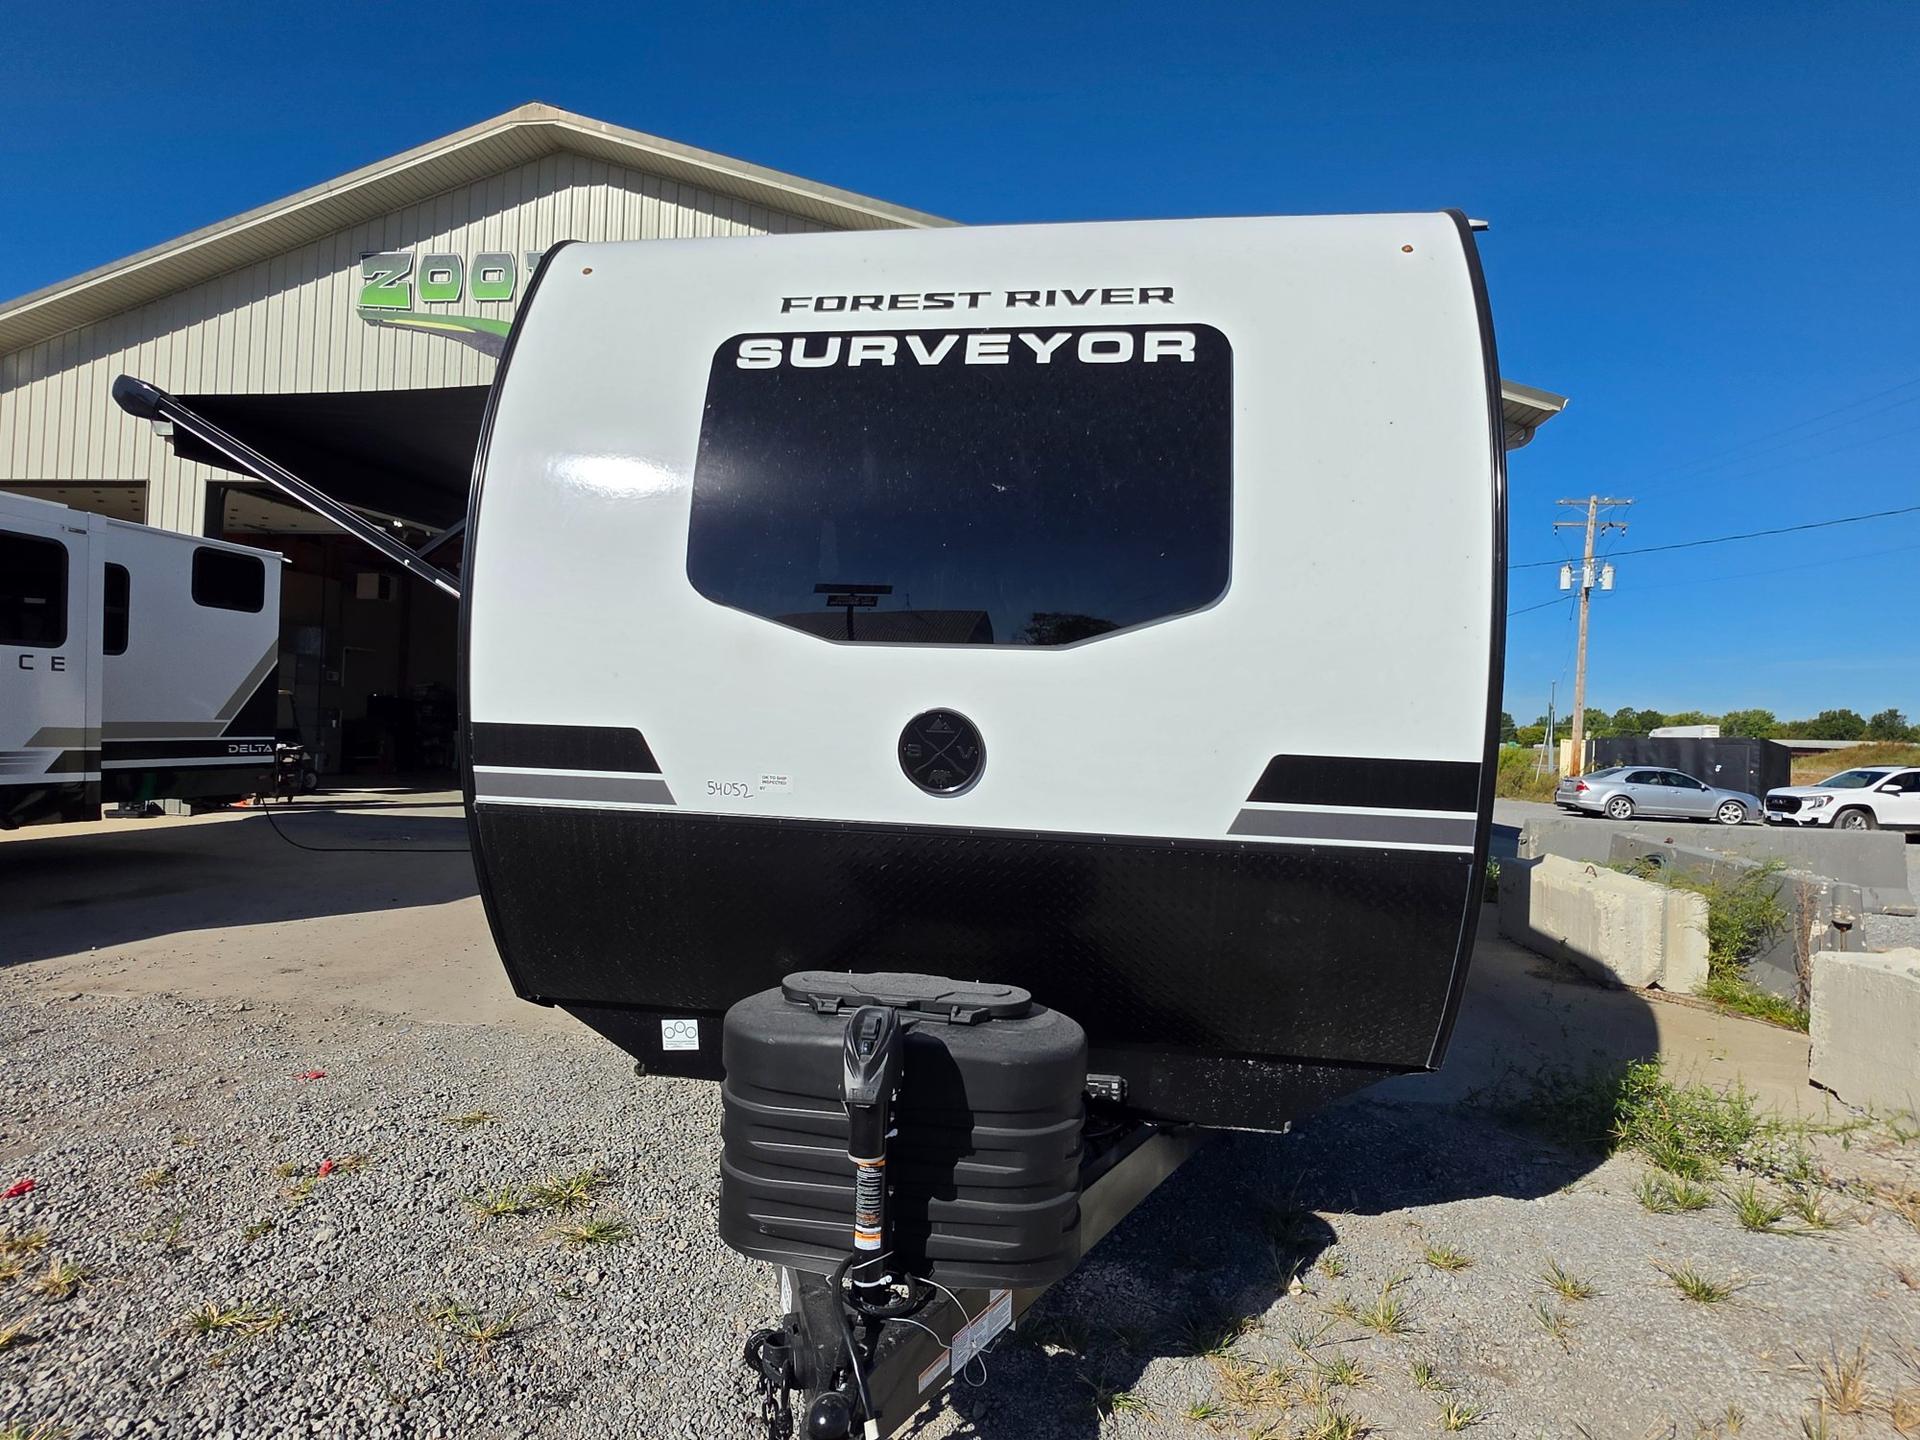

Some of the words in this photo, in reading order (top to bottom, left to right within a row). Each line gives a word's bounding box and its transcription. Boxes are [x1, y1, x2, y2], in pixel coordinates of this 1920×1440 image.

[357, 251, 544, 310] ZOO
[780, 292, 992, 313] FOREST
[1005, 287, 1175, 308] RIVER
[736, 331, 1196, 370] SURVEYOR
[228, 744, 273, 753] DELTA
[707, 780, 754, 799] 54052
